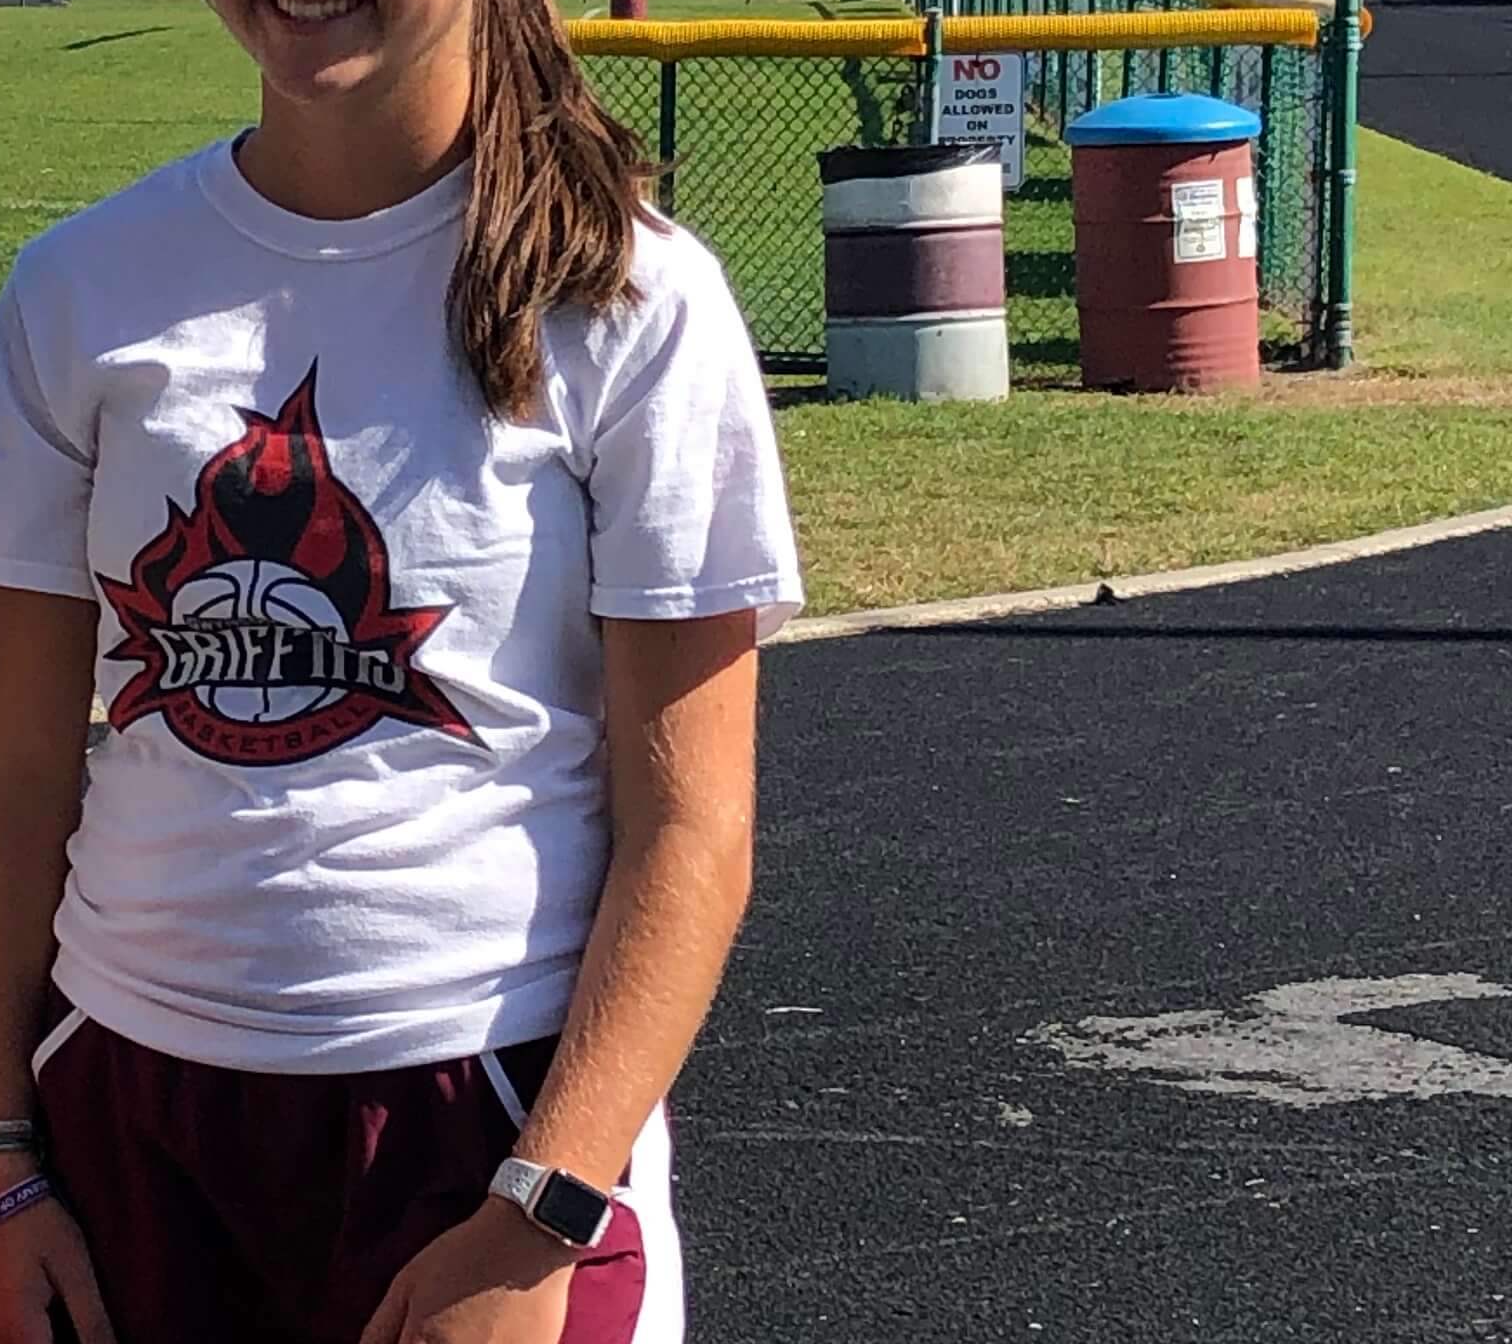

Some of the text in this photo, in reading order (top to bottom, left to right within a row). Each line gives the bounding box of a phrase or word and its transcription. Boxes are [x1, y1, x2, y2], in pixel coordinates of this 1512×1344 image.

[954, 59, 1001, 81] NO
[954, 89, 997, 100] DOGS
[942, 104, 1014, 115] ALLOWED
[967, 121, 988, 130] ON
[173, 700, 373, 753] BASKETBALL
